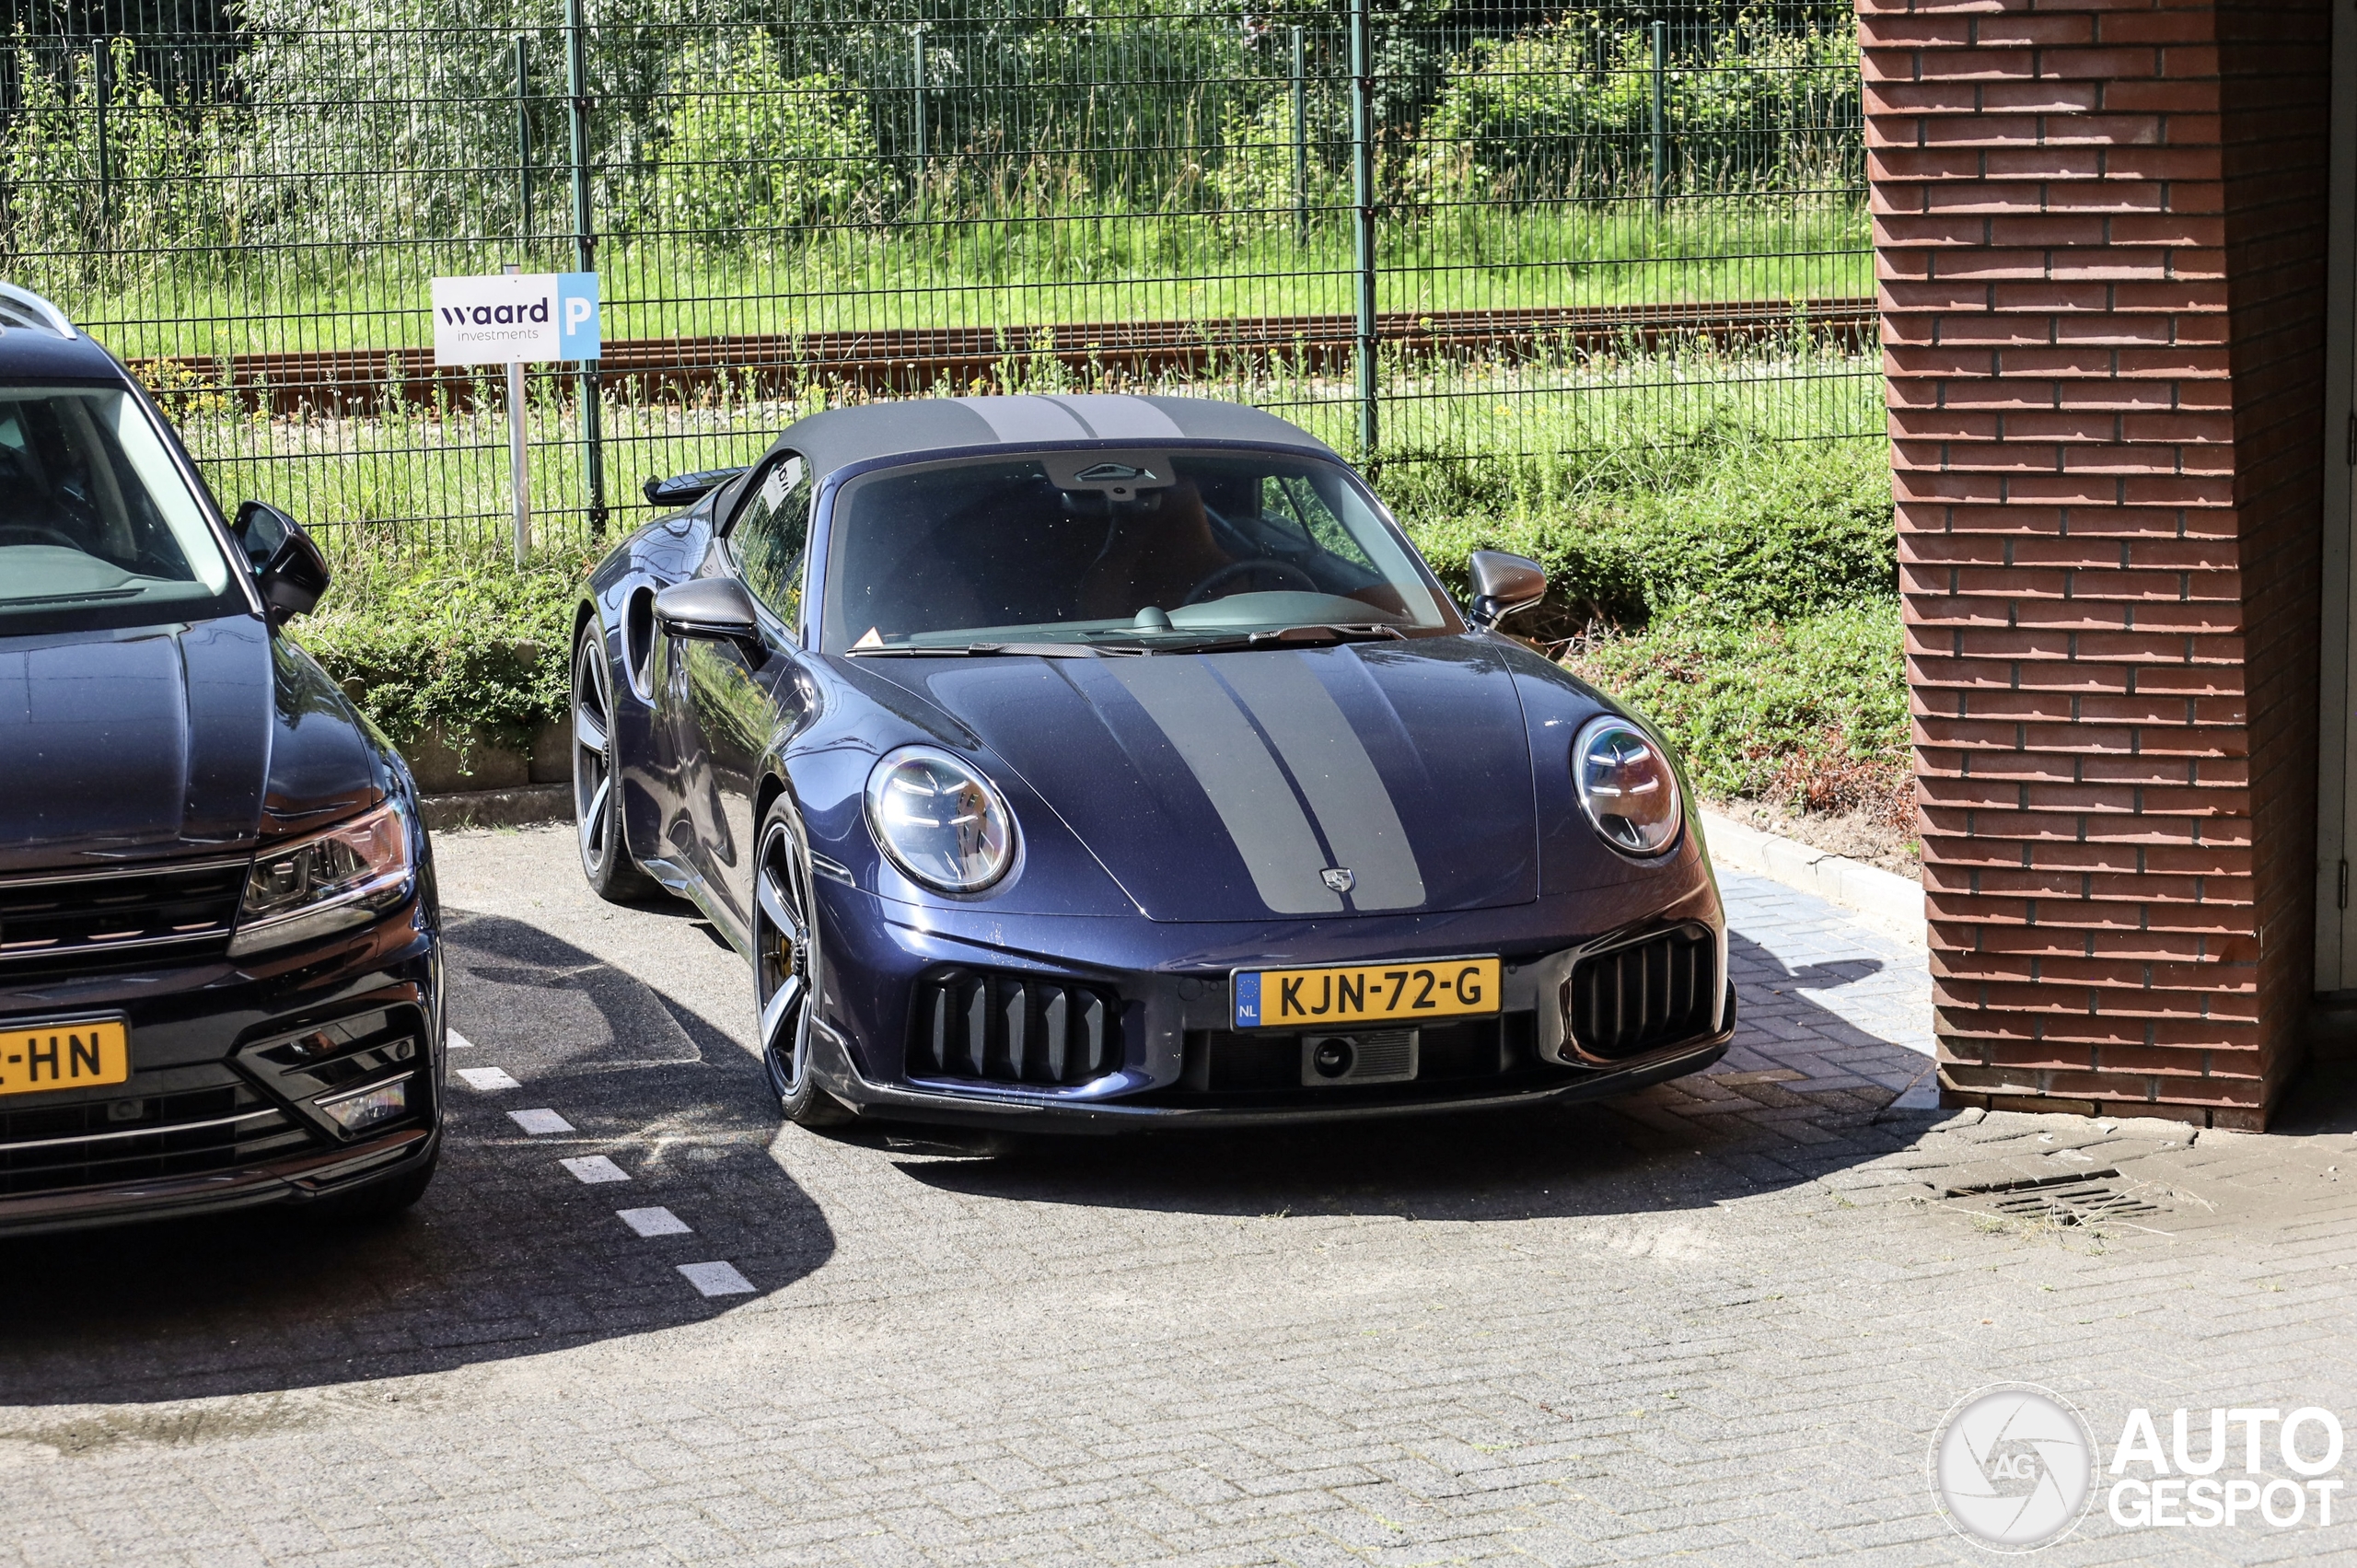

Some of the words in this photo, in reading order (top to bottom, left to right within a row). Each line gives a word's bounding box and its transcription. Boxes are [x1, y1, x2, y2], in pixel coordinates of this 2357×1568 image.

[441, 296, 549, 326] waard
[564, 296, 592, 336] P
[458, 329, 540, 342] investments
[1281, 967, 1481, 1016] KJN-72-G
[1238, 1005, 1258, 1018] NL
[0, 1032, 100, 1085] -HN
